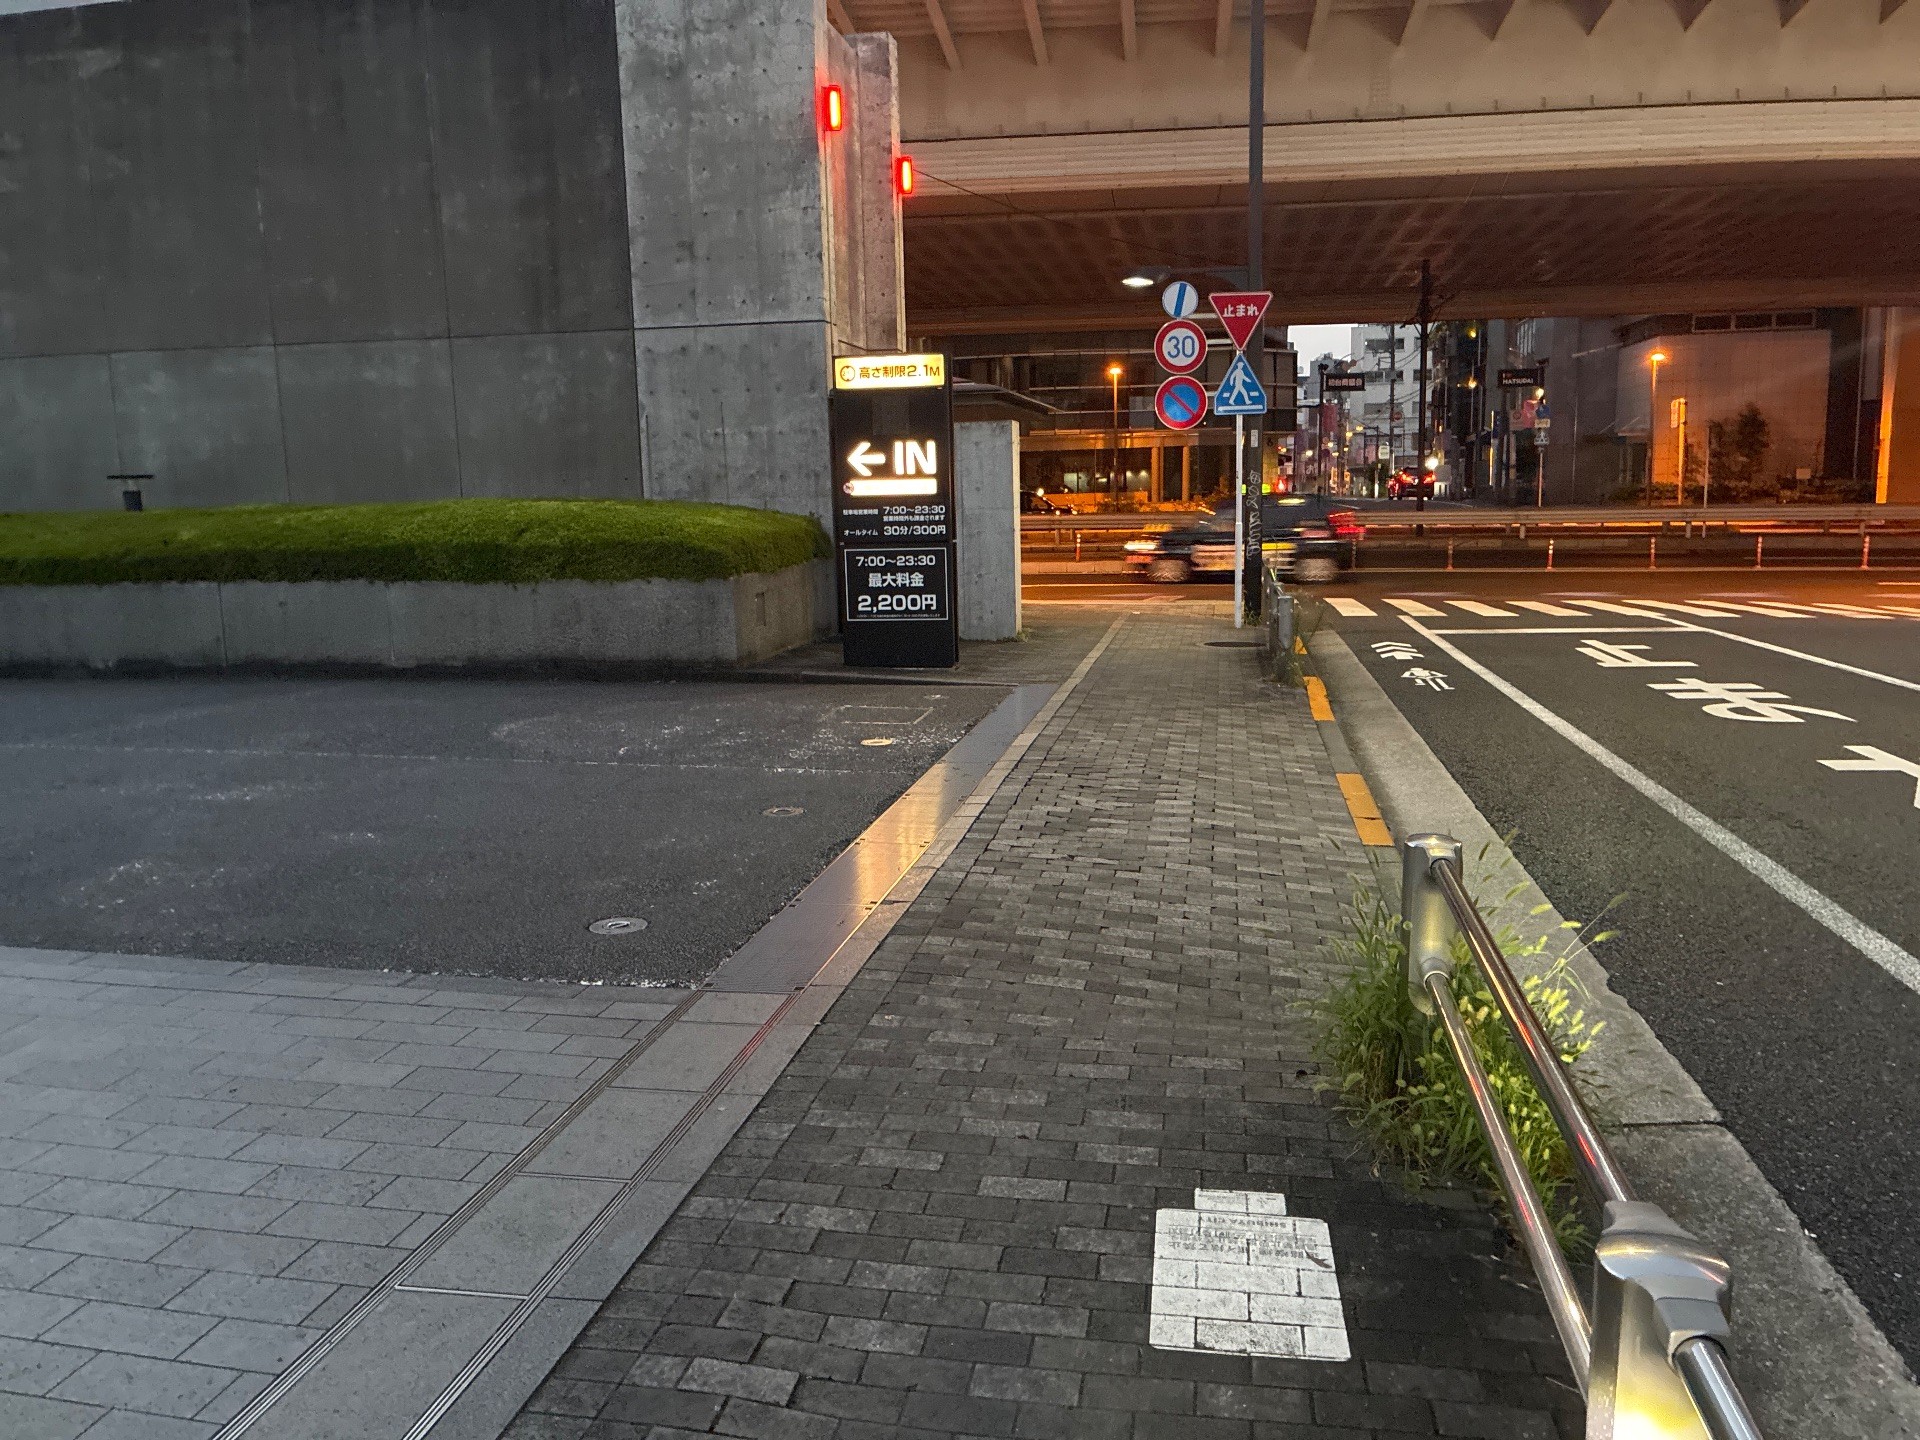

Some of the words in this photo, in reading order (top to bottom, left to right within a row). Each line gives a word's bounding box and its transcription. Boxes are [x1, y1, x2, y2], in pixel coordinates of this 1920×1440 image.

[1222, 304, 1260, 317] 止まれ
[1167, 335, 1195, 359] 30
[859, 364, 940, 379] 高さ制限2.1M
[893, 440, 937, 475] IN
[883, 525, 946, 536] 30分/300円
[868, 572, 925, 588] 最大料金
[857, 594, 937, 613] 2,200円
[1229, 1218, 1286, 1228] SHIBUYA
